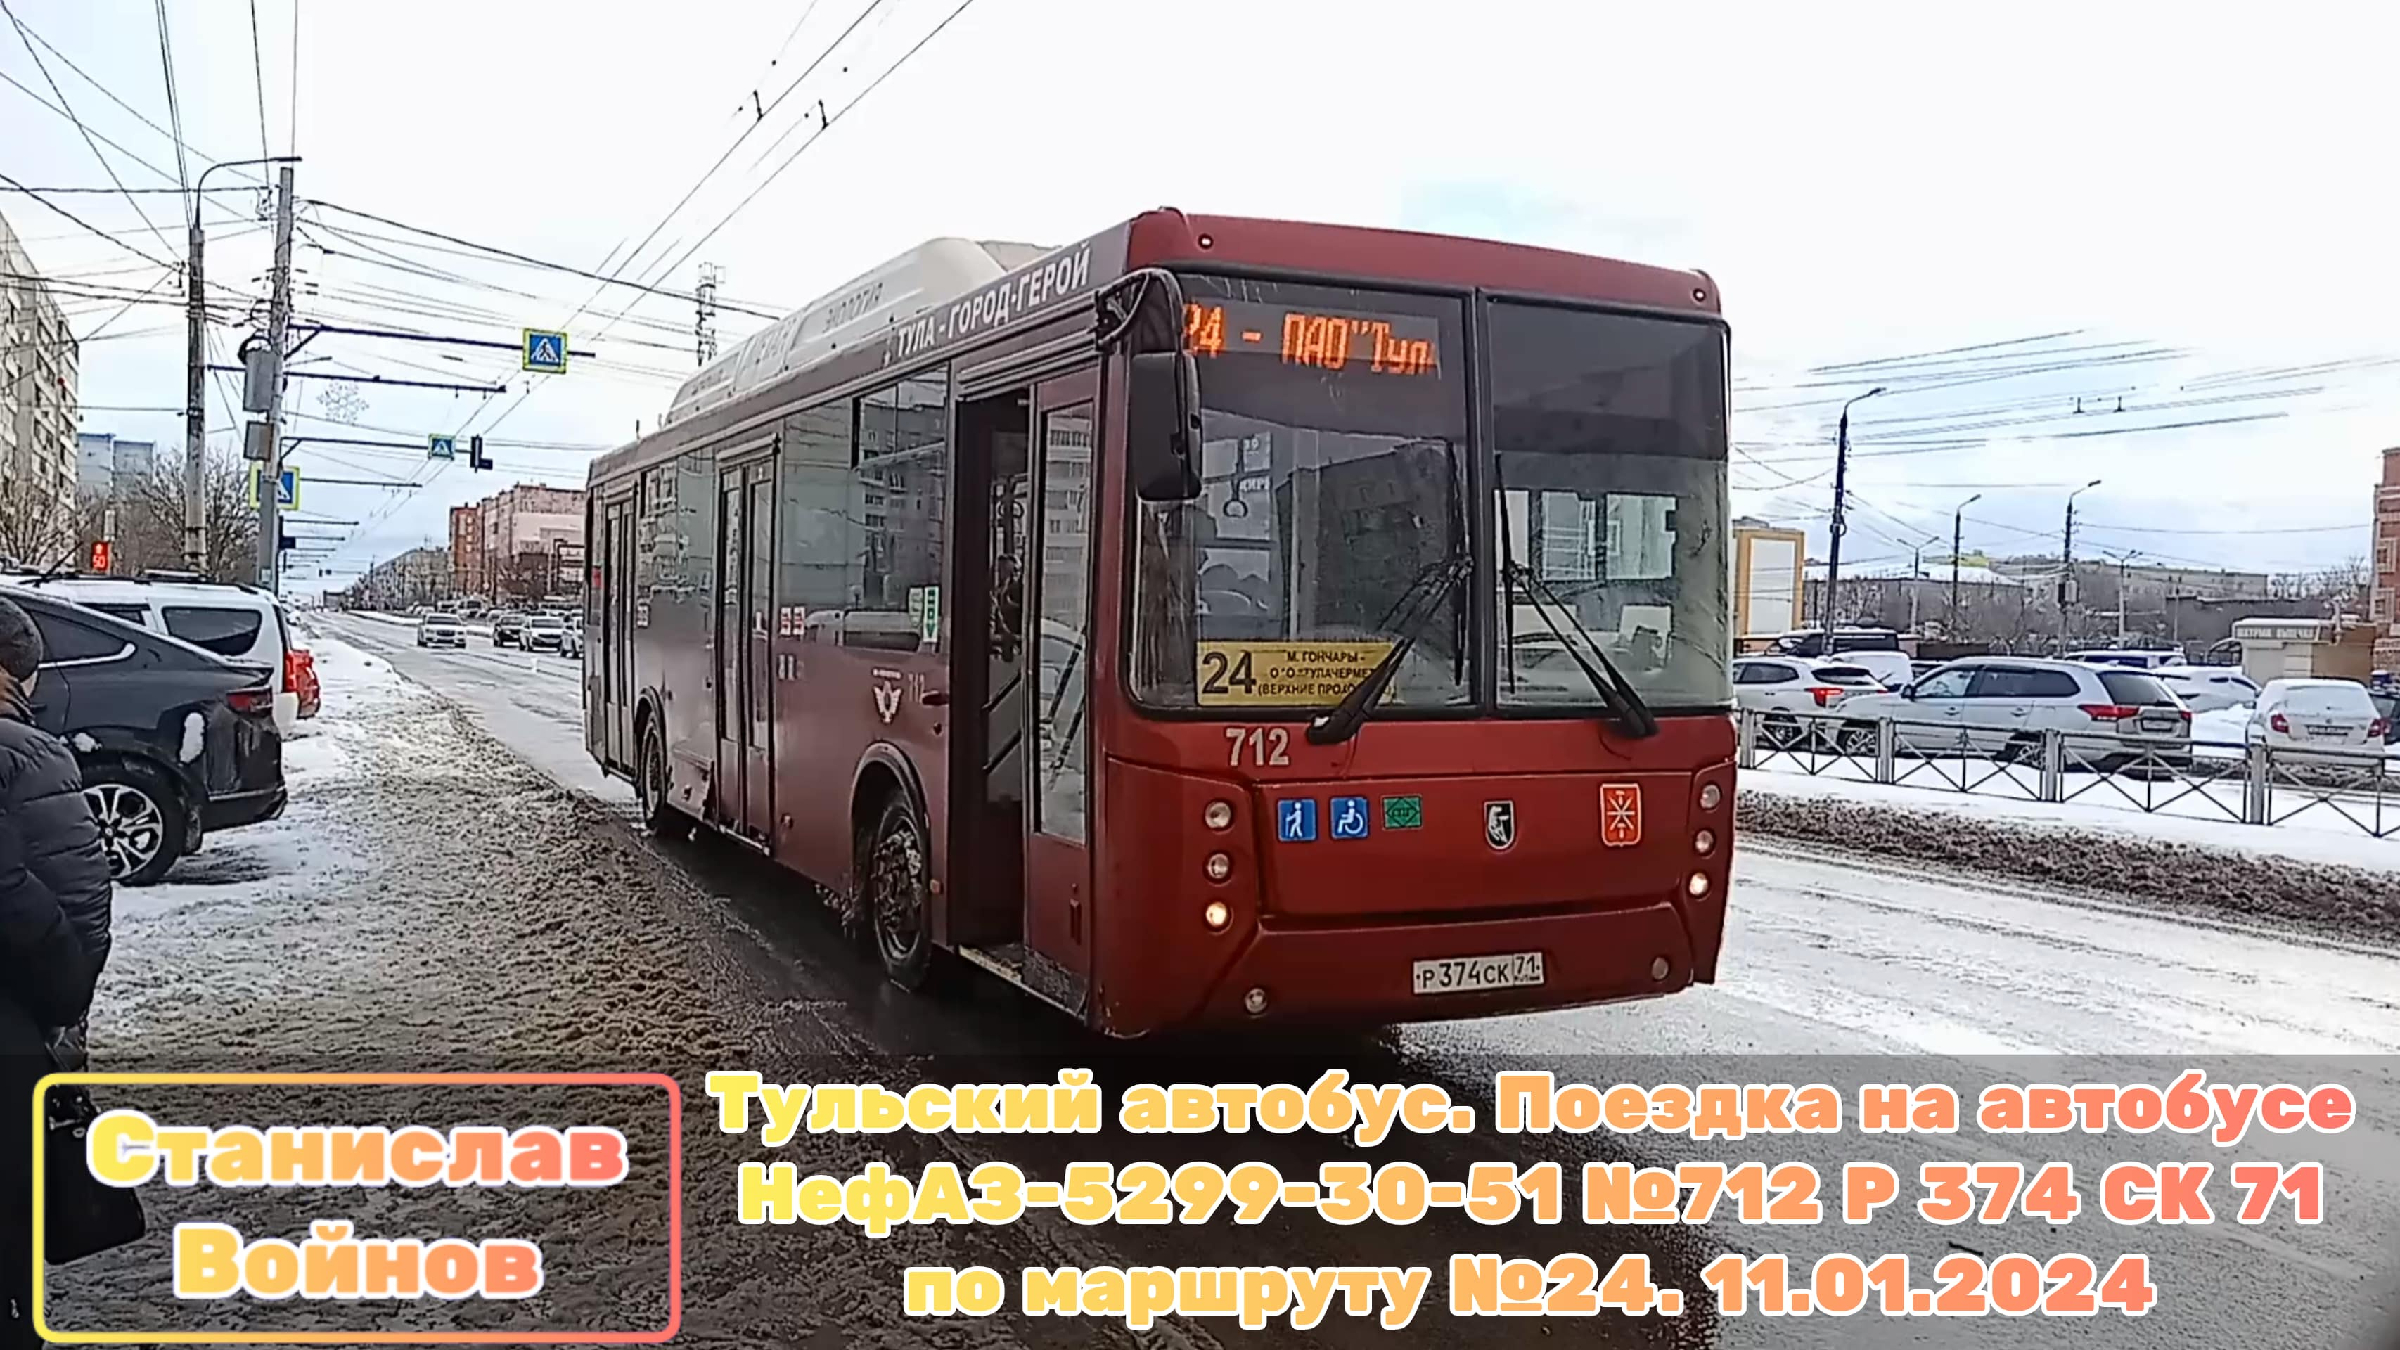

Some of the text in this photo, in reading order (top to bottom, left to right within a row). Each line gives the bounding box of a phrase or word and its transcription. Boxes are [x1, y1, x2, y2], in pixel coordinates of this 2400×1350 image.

[898, 316, 935, 357] ТУЛА
[948, 240, 1090, 339] ГОРОД-ГЕРОЙ
[1202, 651, 1257, 694] 24
[1302, 651, 1358, 663] ГОНЧАРЫ
[1225, 727, 1289, 767] 712
